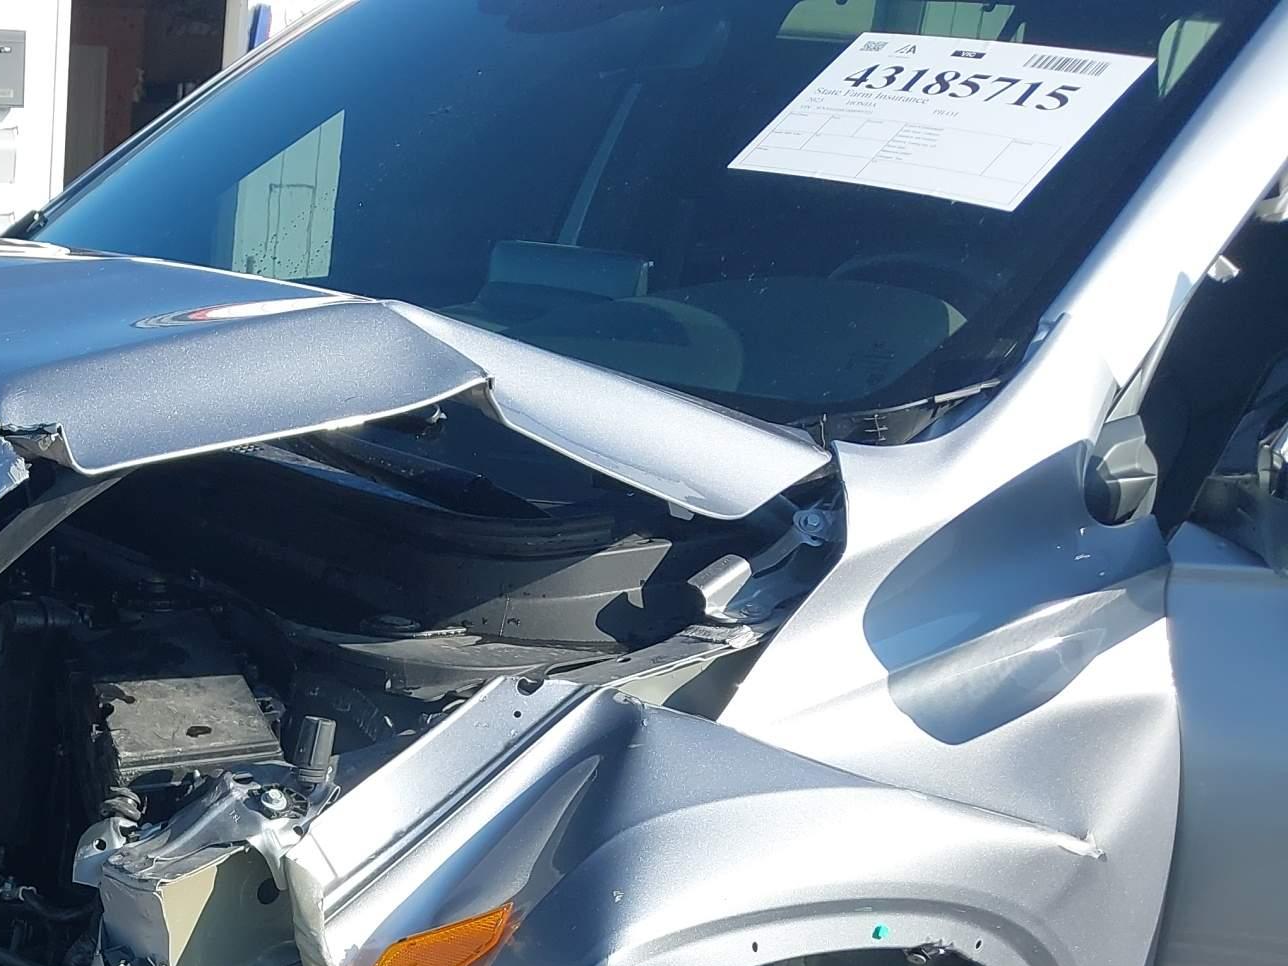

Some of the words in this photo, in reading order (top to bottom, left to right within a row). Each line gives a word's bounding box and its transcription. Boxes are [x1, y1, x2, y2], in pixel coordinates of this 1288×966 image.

[814, 87, 842, 96] State
[843, 89, 873, 99] Farm
[874, 91, 930, 104] Insurance
[843, 63, 1081, 111] 43185715
